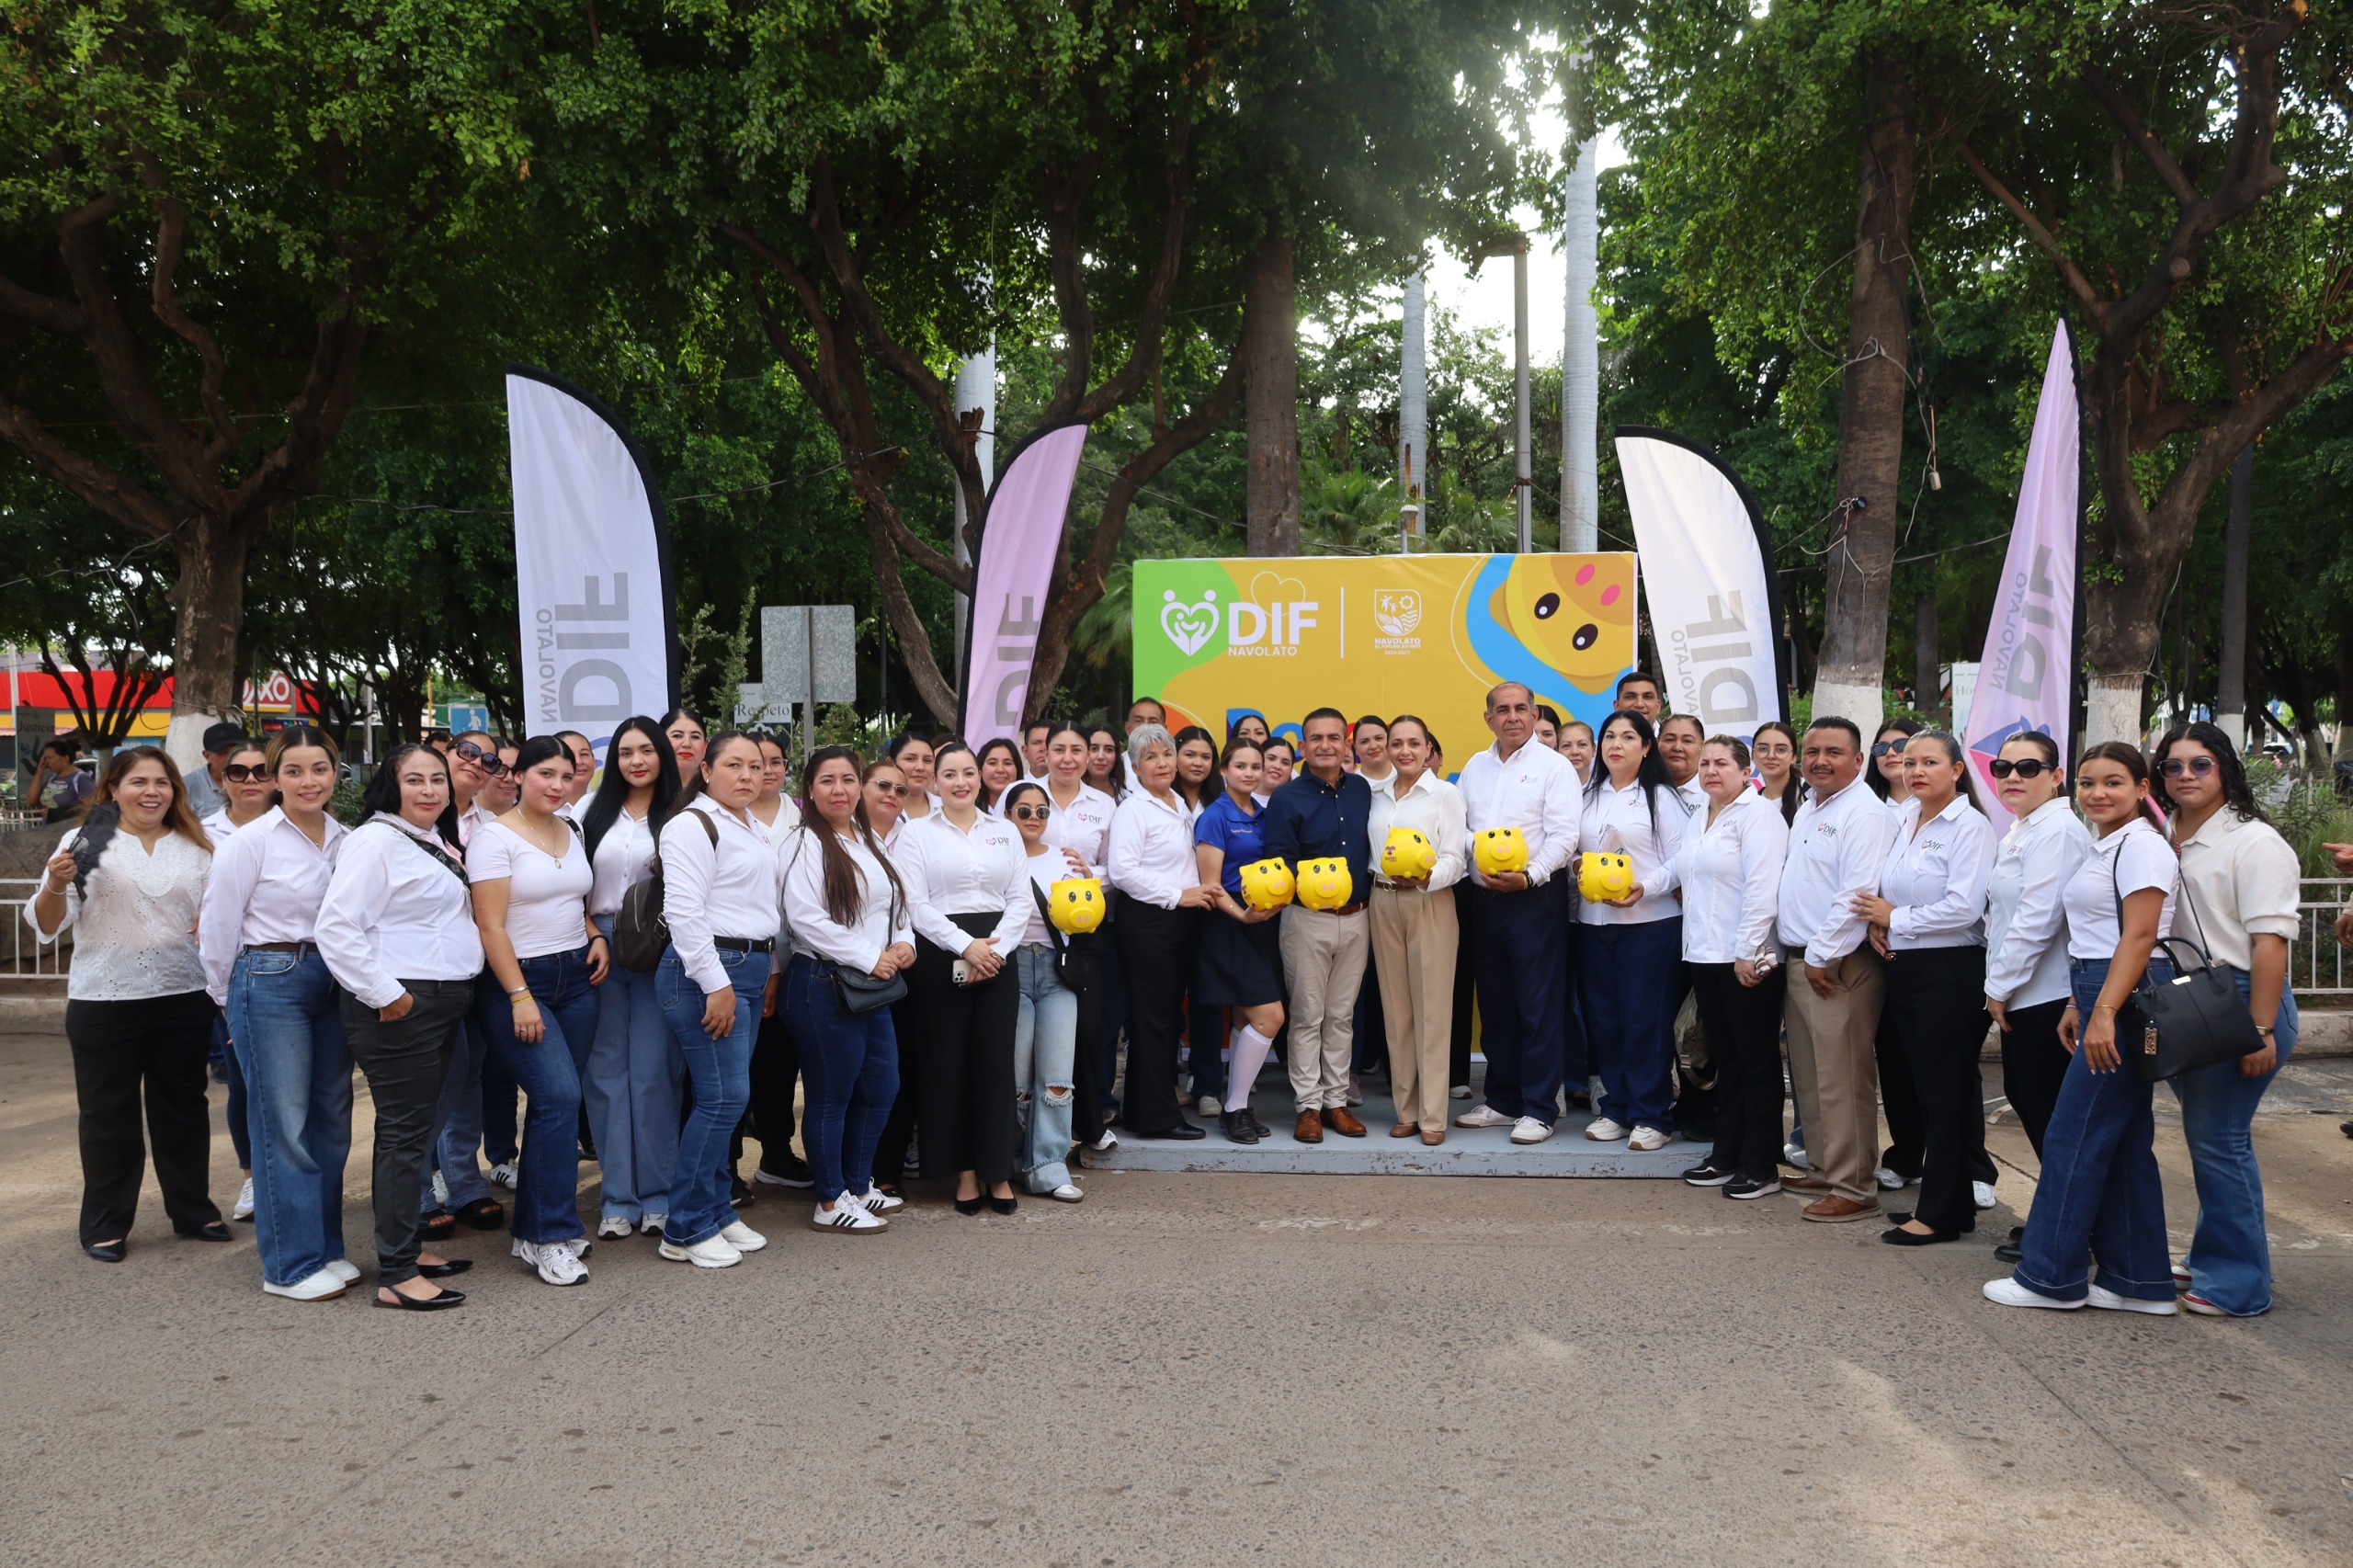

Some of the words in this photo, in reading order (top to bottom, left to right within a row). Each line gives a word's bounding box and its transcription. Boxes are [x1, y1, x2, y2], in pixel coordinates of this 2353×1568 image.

[1228, 602, 1319, 645] DIF
[1228, 646, 1297, 656] NAVOLATO
[18, 722, 54, 733] Justicia
[1088, 814, 1102, 824] DIF
[1824, 825, 1836, 835] DIF
[996, 836, 1010, 845] DIF
